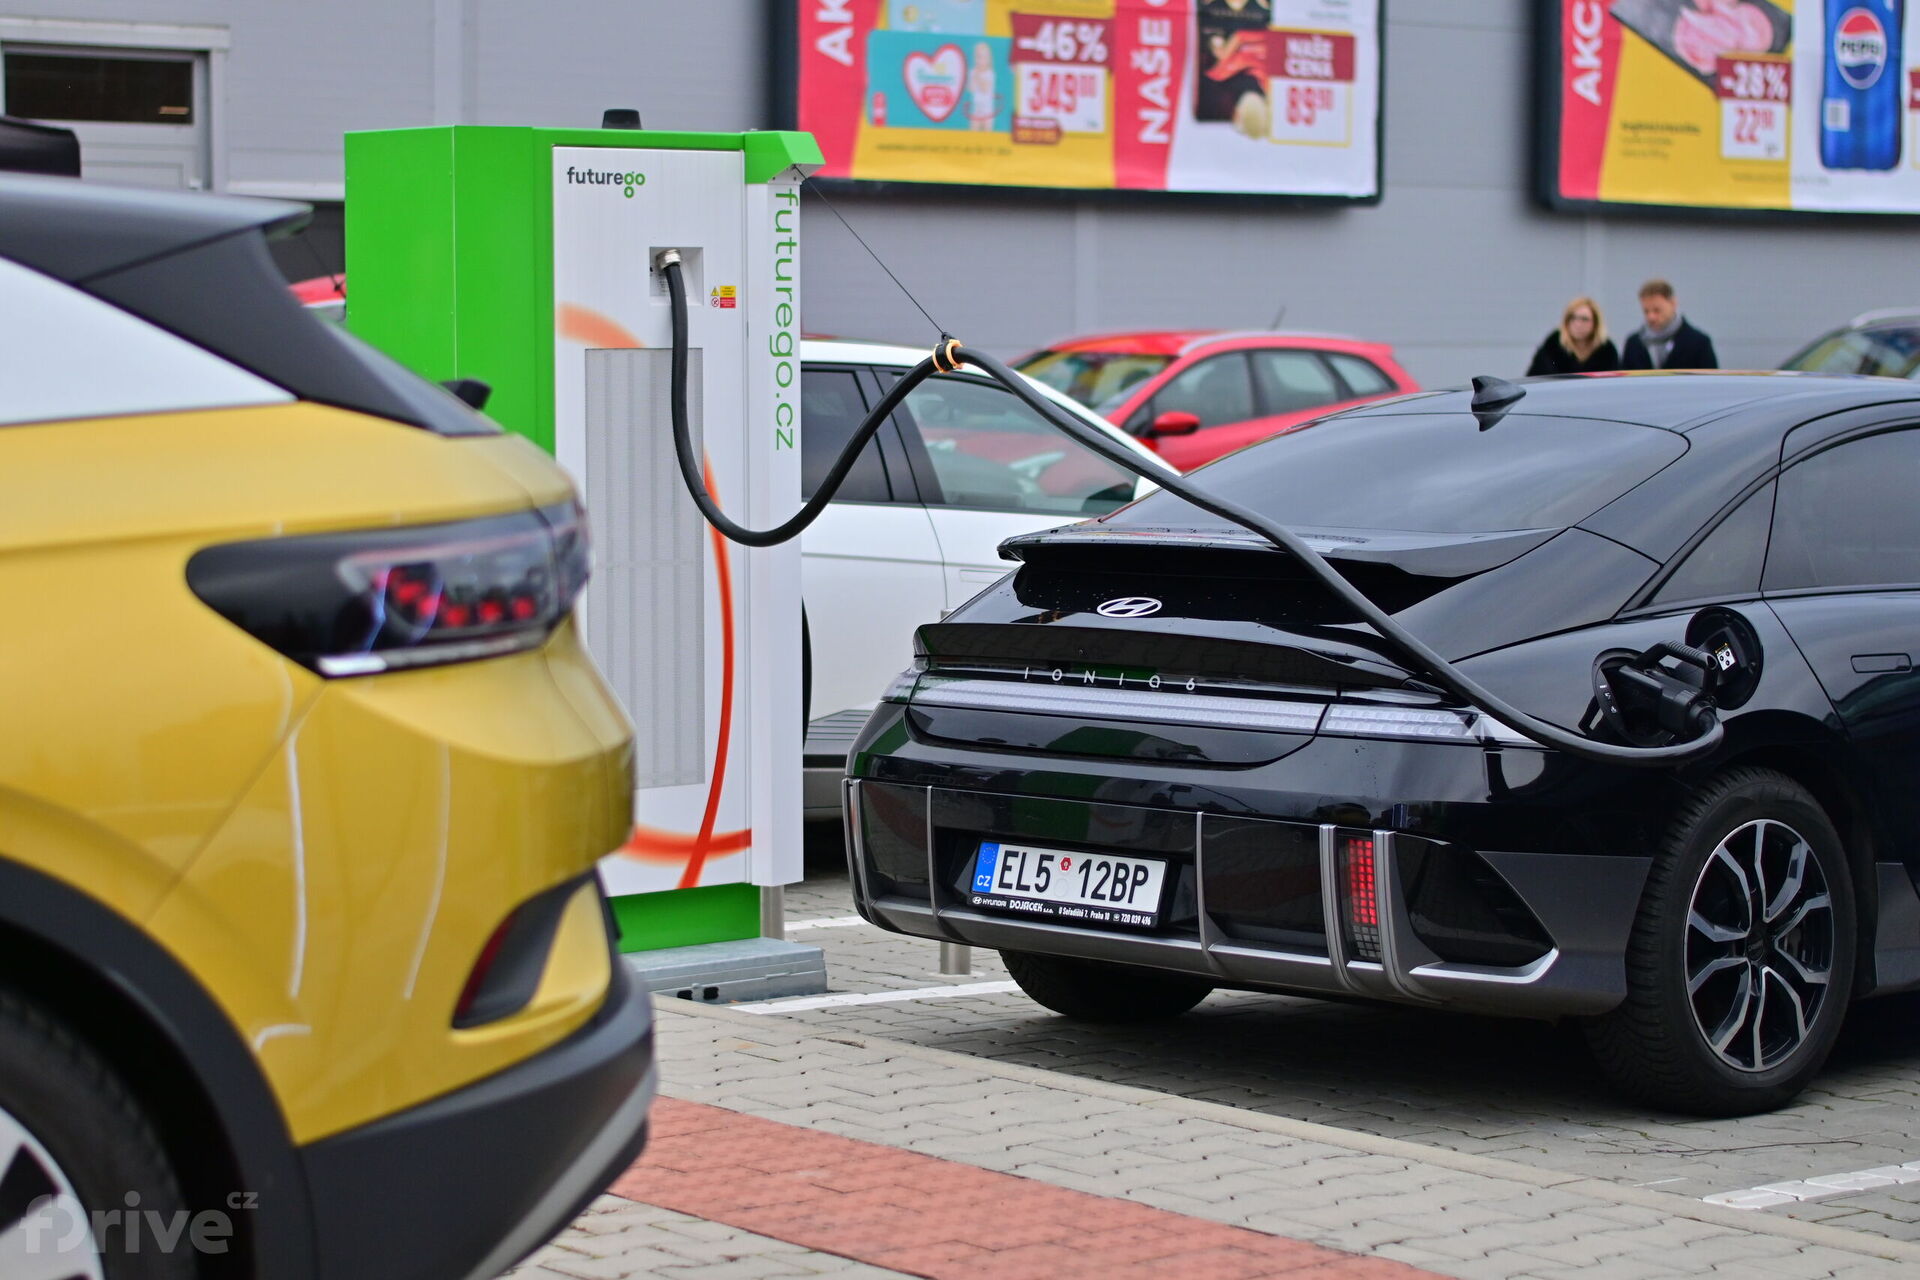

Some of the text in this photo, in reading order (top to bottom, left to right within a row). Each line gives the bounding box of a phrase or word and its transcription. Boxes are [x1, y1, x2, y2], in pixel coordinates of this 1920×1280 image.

[1018, 20, 1108, 63] -46%
[567, 166, 646, 199] futurego
[769, 188, 799, 450] futurego.cz
[1185, 677, 1196, 691] 6
[976, 874, 991, 888] CZ
[997, 849, 1150, 904] EL5 12BP
[982, 898, 1007, 907] HYUNDAI
